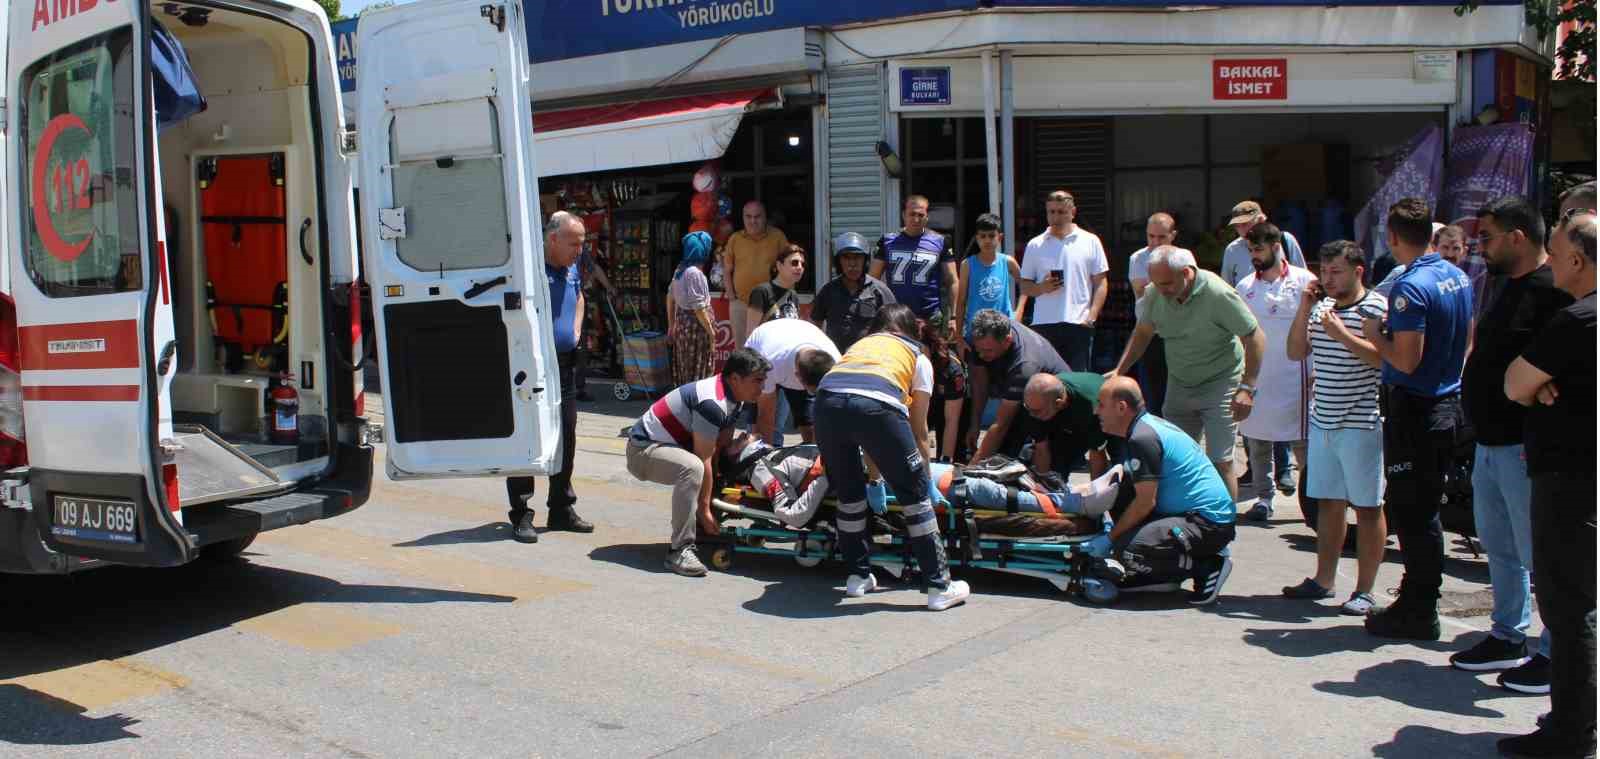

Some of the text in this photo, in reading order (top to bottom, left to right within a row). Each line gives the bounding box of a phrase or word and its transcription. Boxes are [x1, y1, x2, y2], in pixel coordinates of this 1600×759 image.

[1219, 66, 1282, 78] BAKKAL
[52, 159, 91, 213] 112
[889, 250, 938, 285] 77
[61, 501, 135, 532] 09 AJ 669
